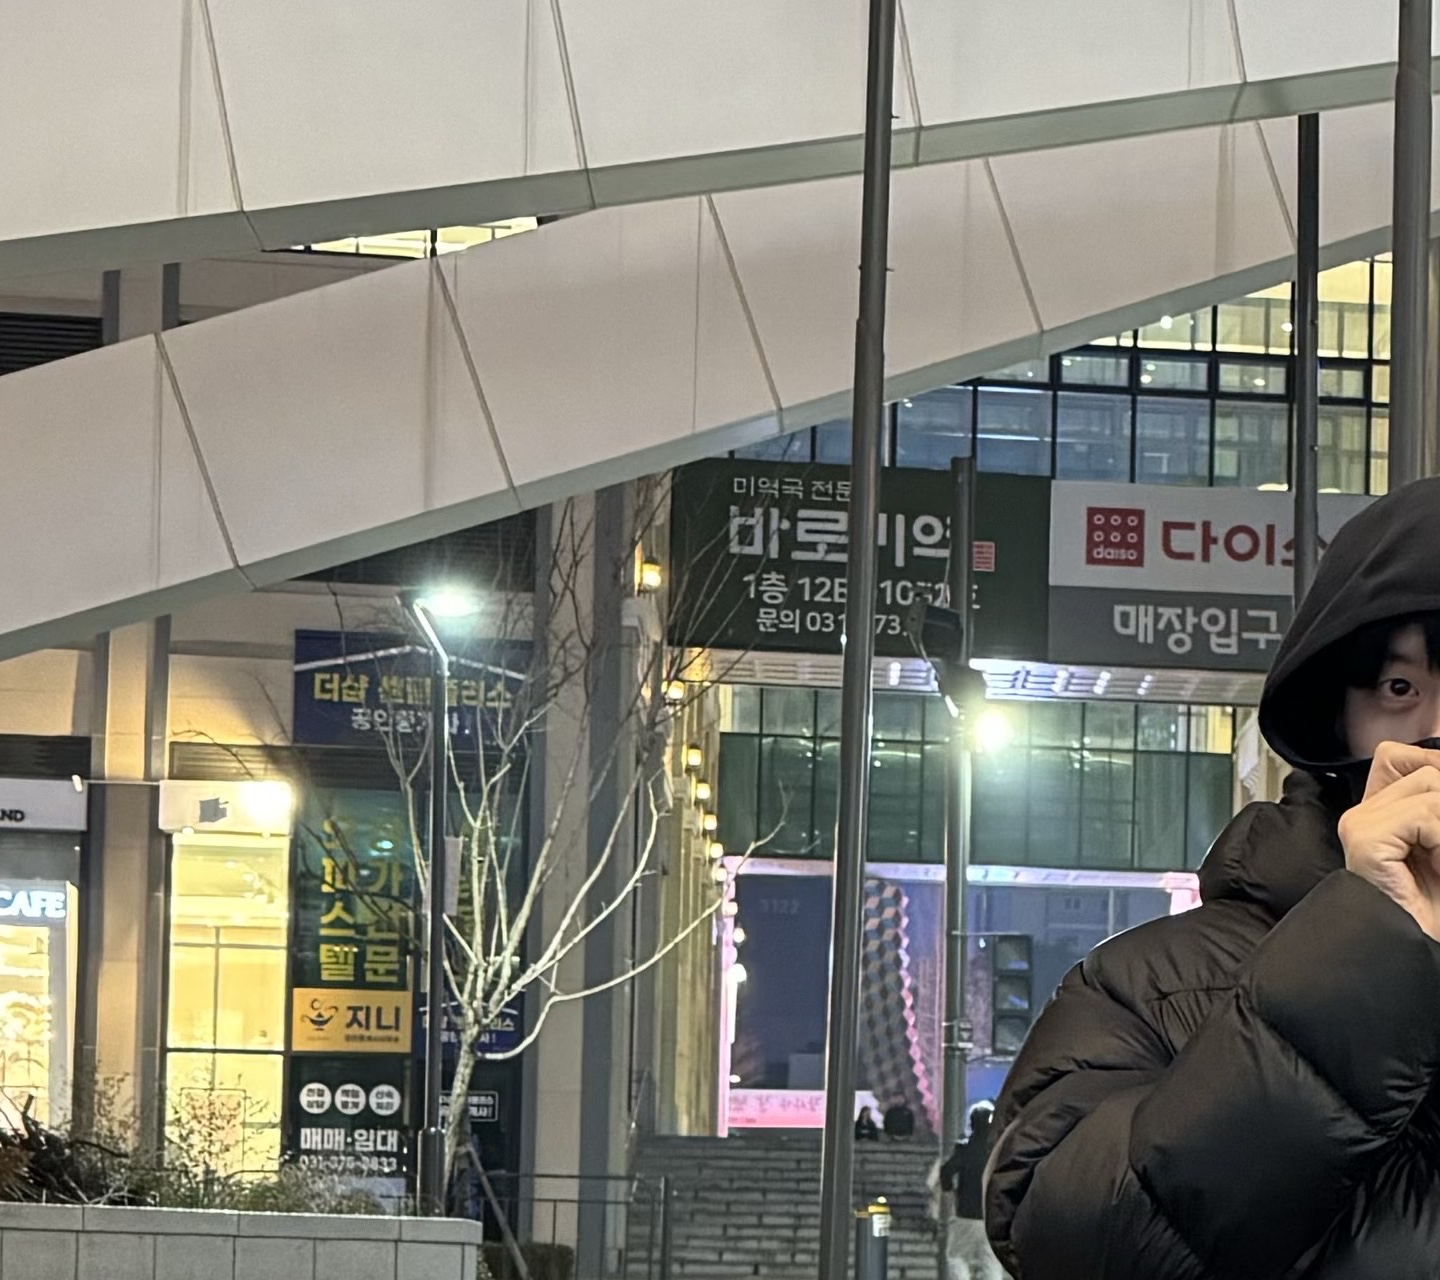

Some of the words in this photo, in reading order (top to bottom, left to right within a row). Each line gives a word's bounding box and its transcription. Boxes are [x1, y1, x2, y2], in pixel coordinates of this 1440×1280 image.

[733, 477, 804, 499] 미역국
[1093, 545, 1138, 561] daiso
[743, 571, 789, 604] 1층
[757, 607, 800, 634] 문의
[1113, 604, 1283, 655] 매장입구
[0, 809, 25, 822] ND
[345, 1004, 400, 1032] 지니
